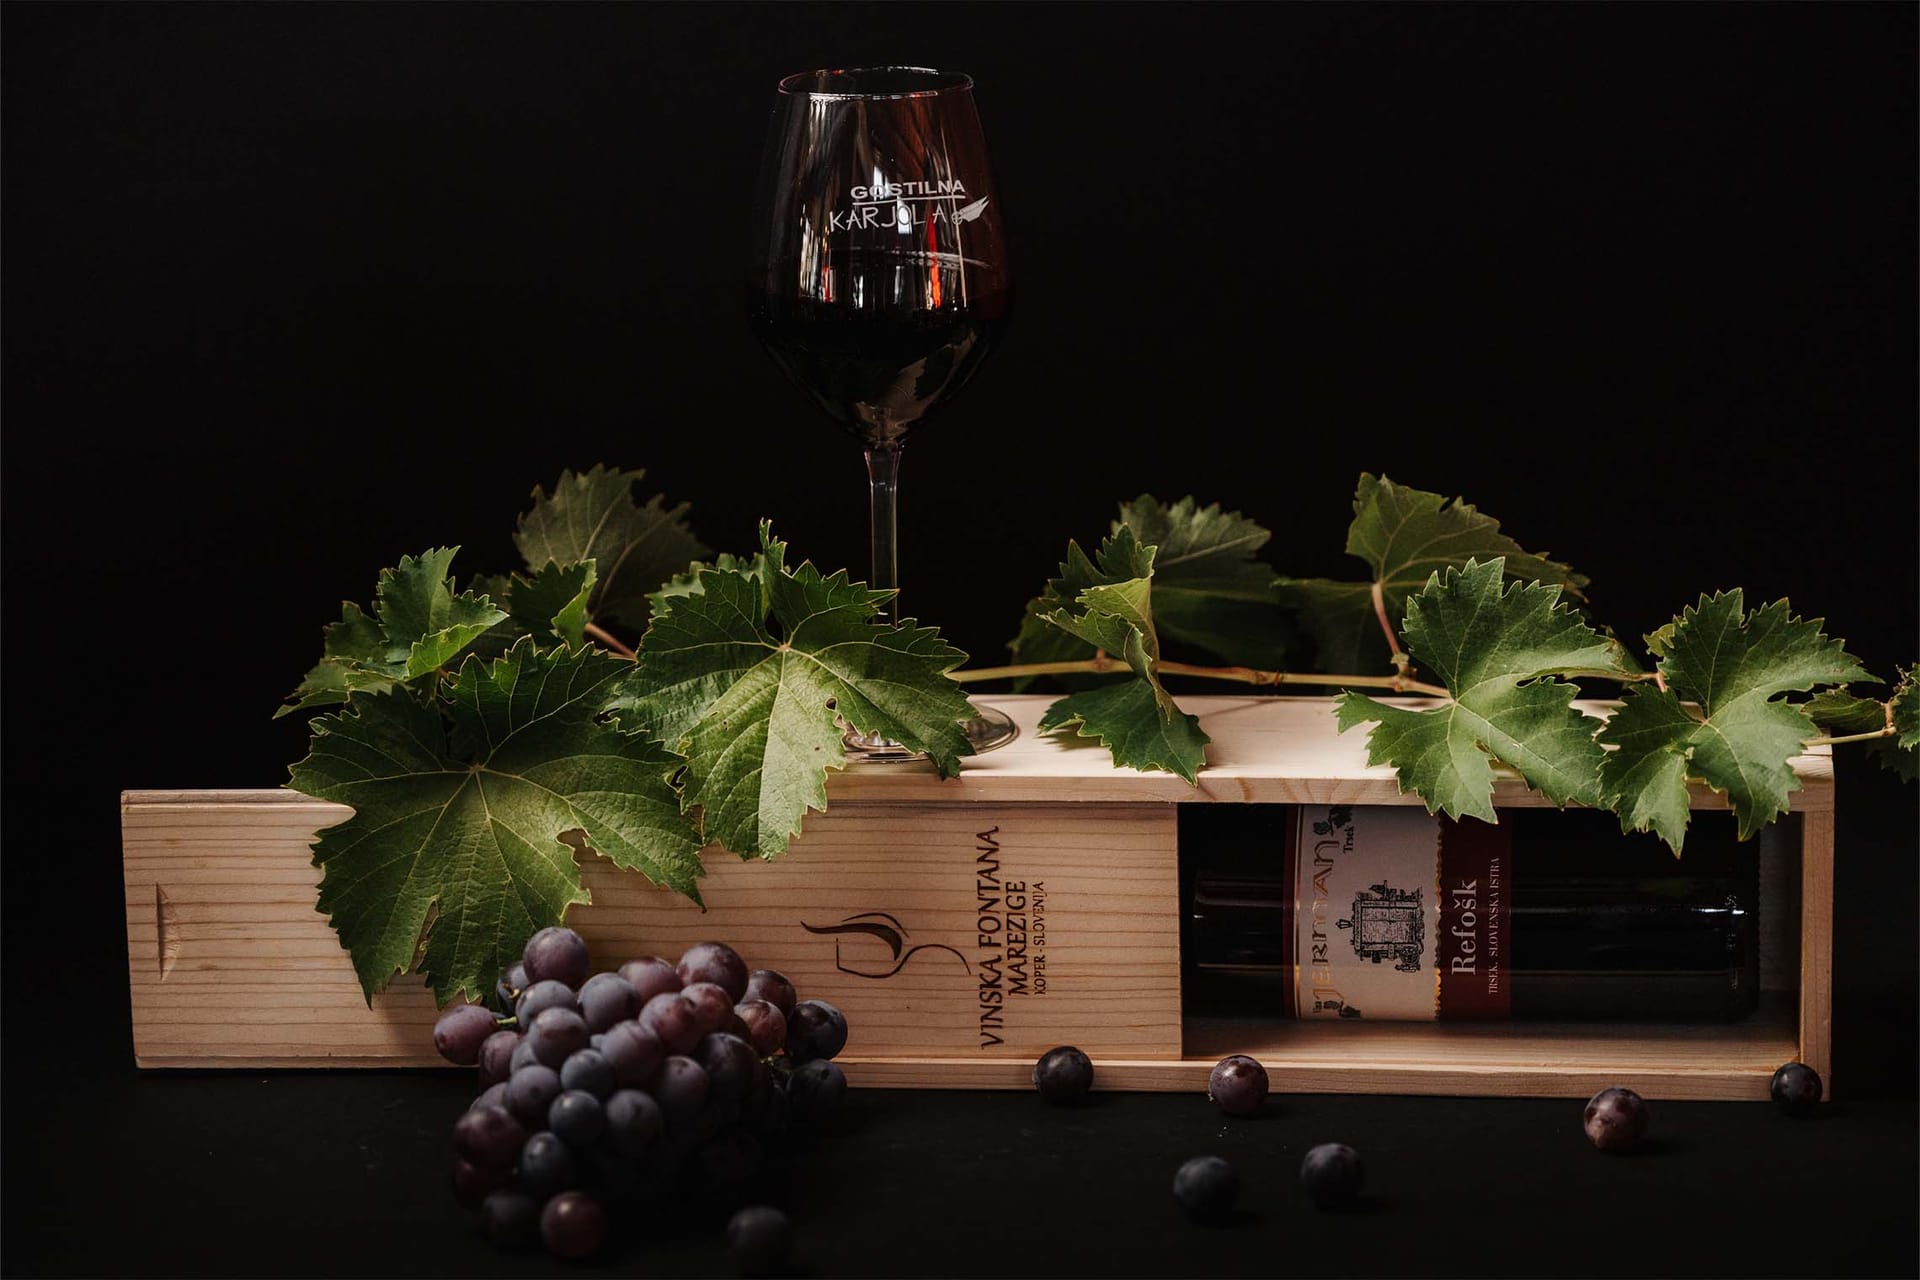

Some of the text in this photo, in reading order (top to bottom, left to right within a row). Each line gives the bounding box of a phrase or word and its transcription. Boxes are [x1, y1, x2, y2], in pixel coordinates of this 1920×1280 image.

[850, 180, 966, 200] GOSTILNA
[829, 203, 947, 233] KARJOLA
[1342, 826, 1355, 854] Trsek
[1489, 857, 1500, 889] ISTRA
[976, 826, 1004, 1049] VINSKA FONTANA
[1006, 881, 1030, 996] MAREZIGE
[1032, 881, 1047, 946] SLOVENIJA
[1451, 879, 1477, 976] Refošk
[1488, 891, 1500, 957] SLOVENSKA
[1033, 954, 1046, 995] KOPER
